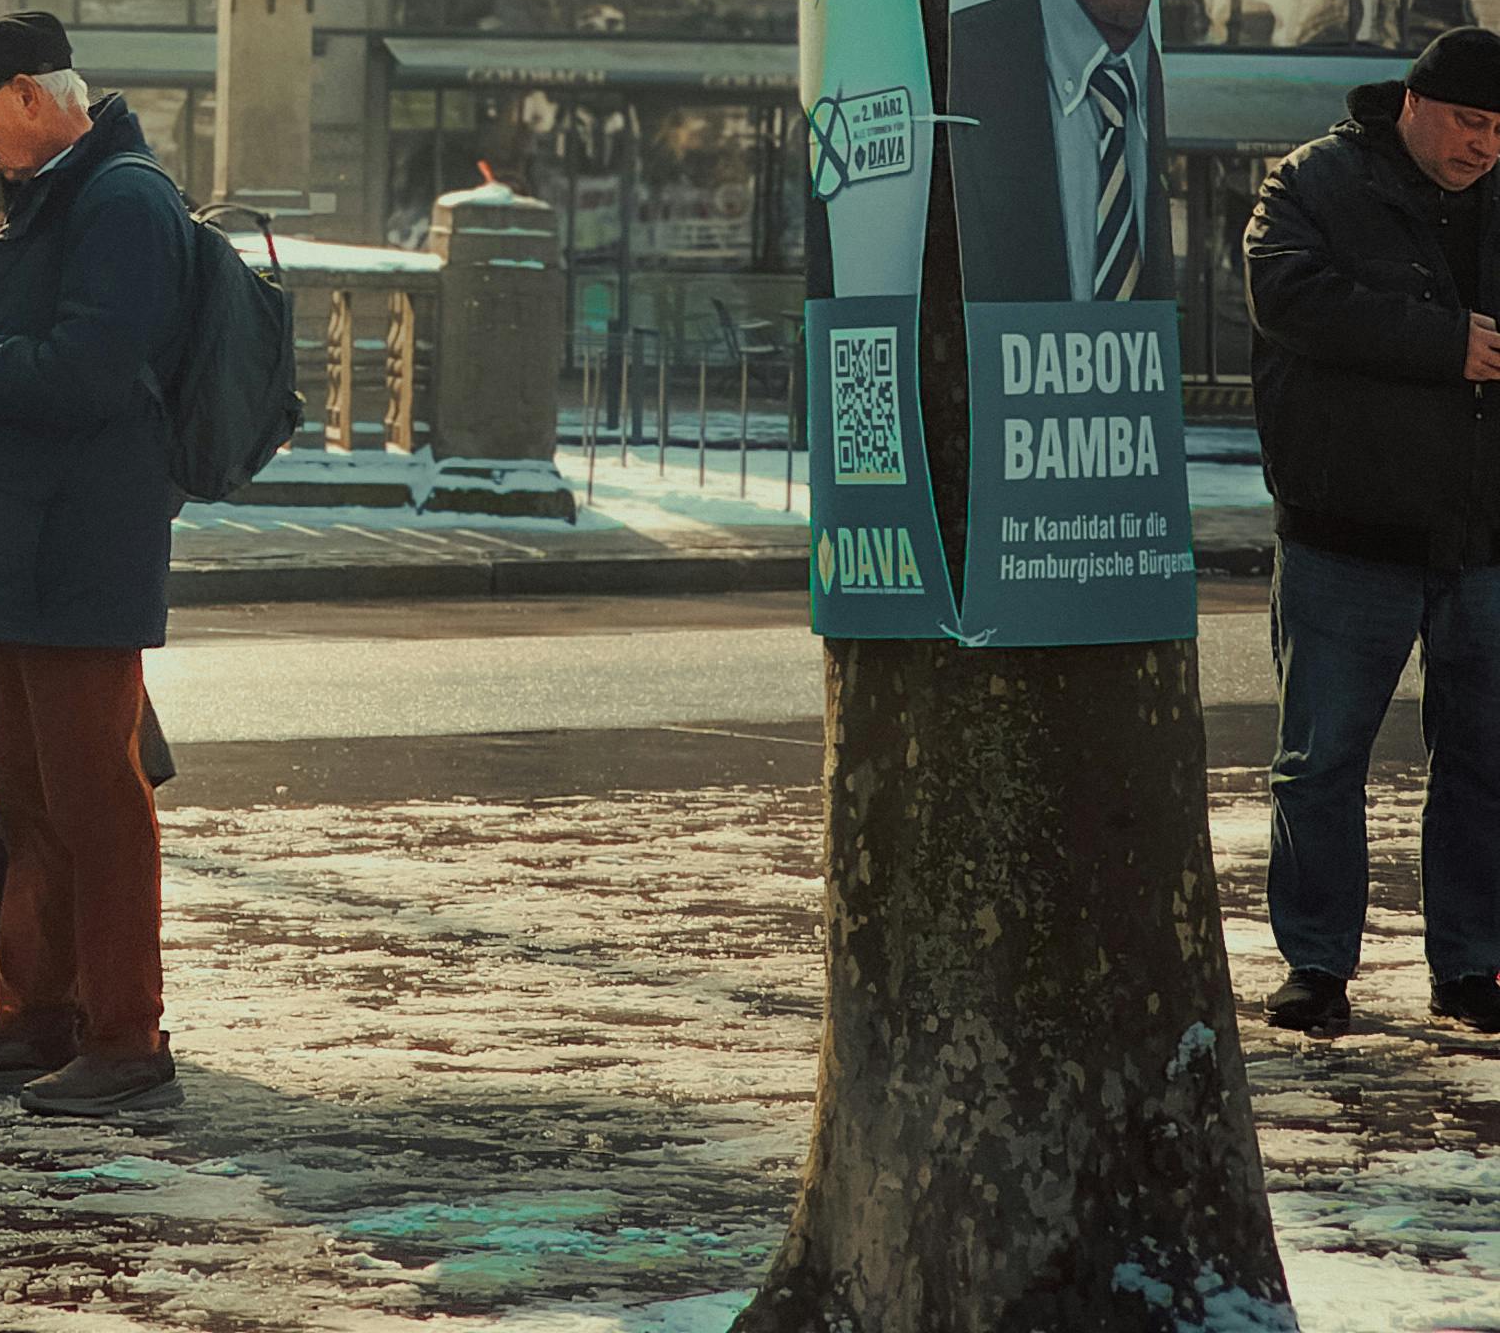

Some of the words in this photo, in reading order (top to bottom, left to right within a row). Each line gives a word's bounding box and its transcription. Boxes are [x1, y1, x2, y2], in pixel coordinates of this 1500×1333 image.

[872, 95, 903, 120] MÄRZ
[868, 136, 905, 167] DAVA
[1002, 331, 1164, 395] DABOYA
[1004, 415, 1159, 480] BAMBA
[1002, 517, 1028, 542] Ihr
[1035, 515, 1115, 542] Kandidat
[1120, 513, 1142, 538] für
[1146, 512, 1167, 537] die
[837, 527, 923, 587] DAVA
[1001, 551, 1134, 583] Hamburgische
